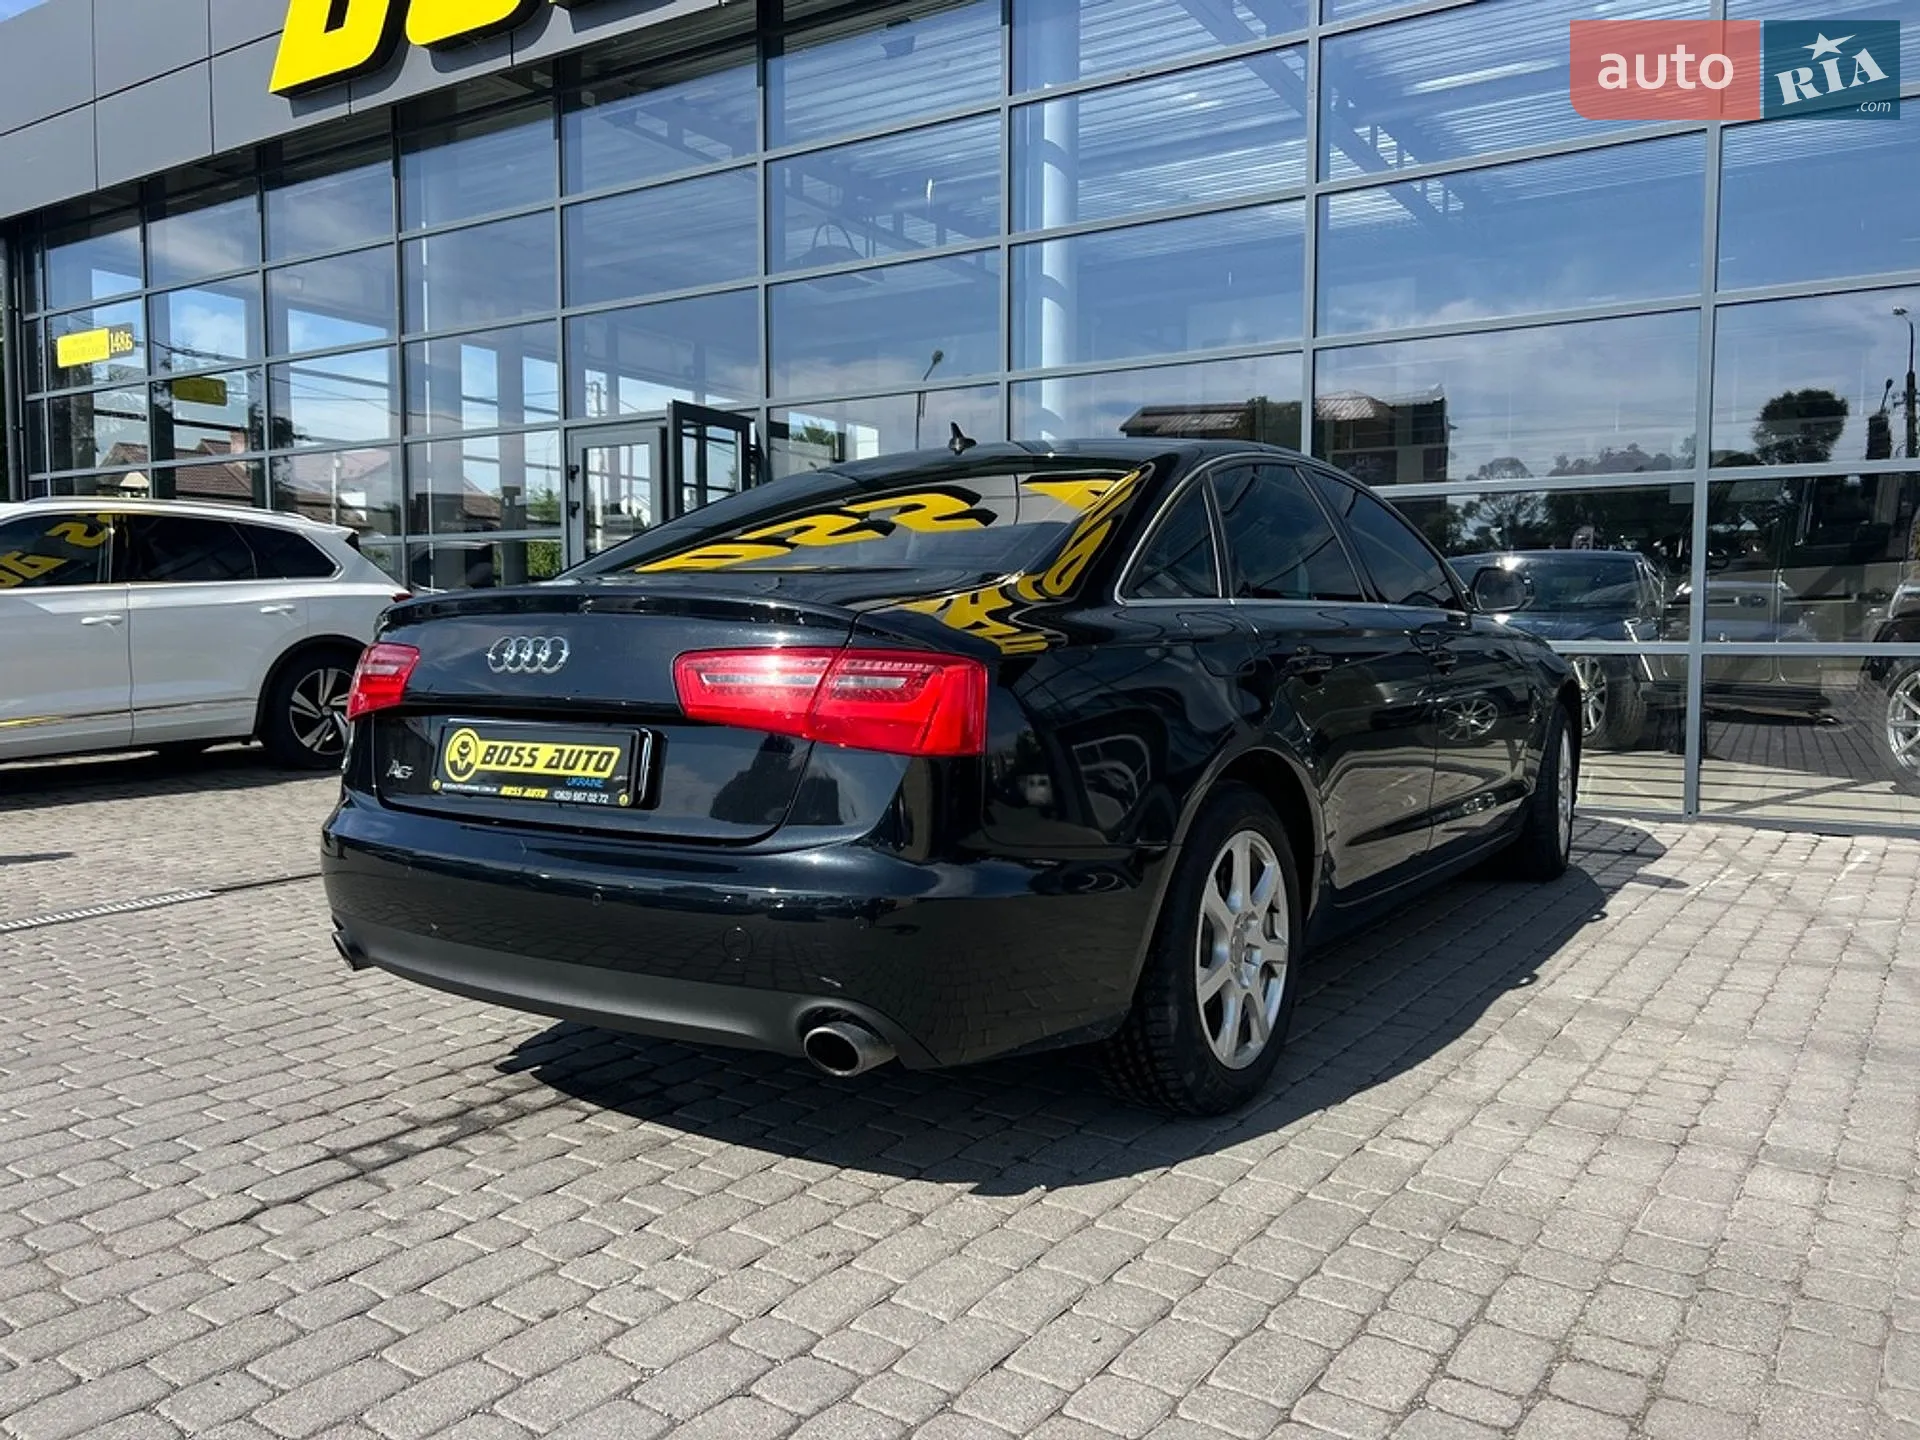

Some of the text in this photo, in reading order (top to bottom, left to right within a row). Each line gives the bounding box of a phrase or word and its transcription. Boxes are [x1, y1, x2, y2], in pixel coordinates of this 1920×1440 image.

[480, 744, 616, 773] BOSS AUTO
[565, 776, 604, 788] UKRAINE
